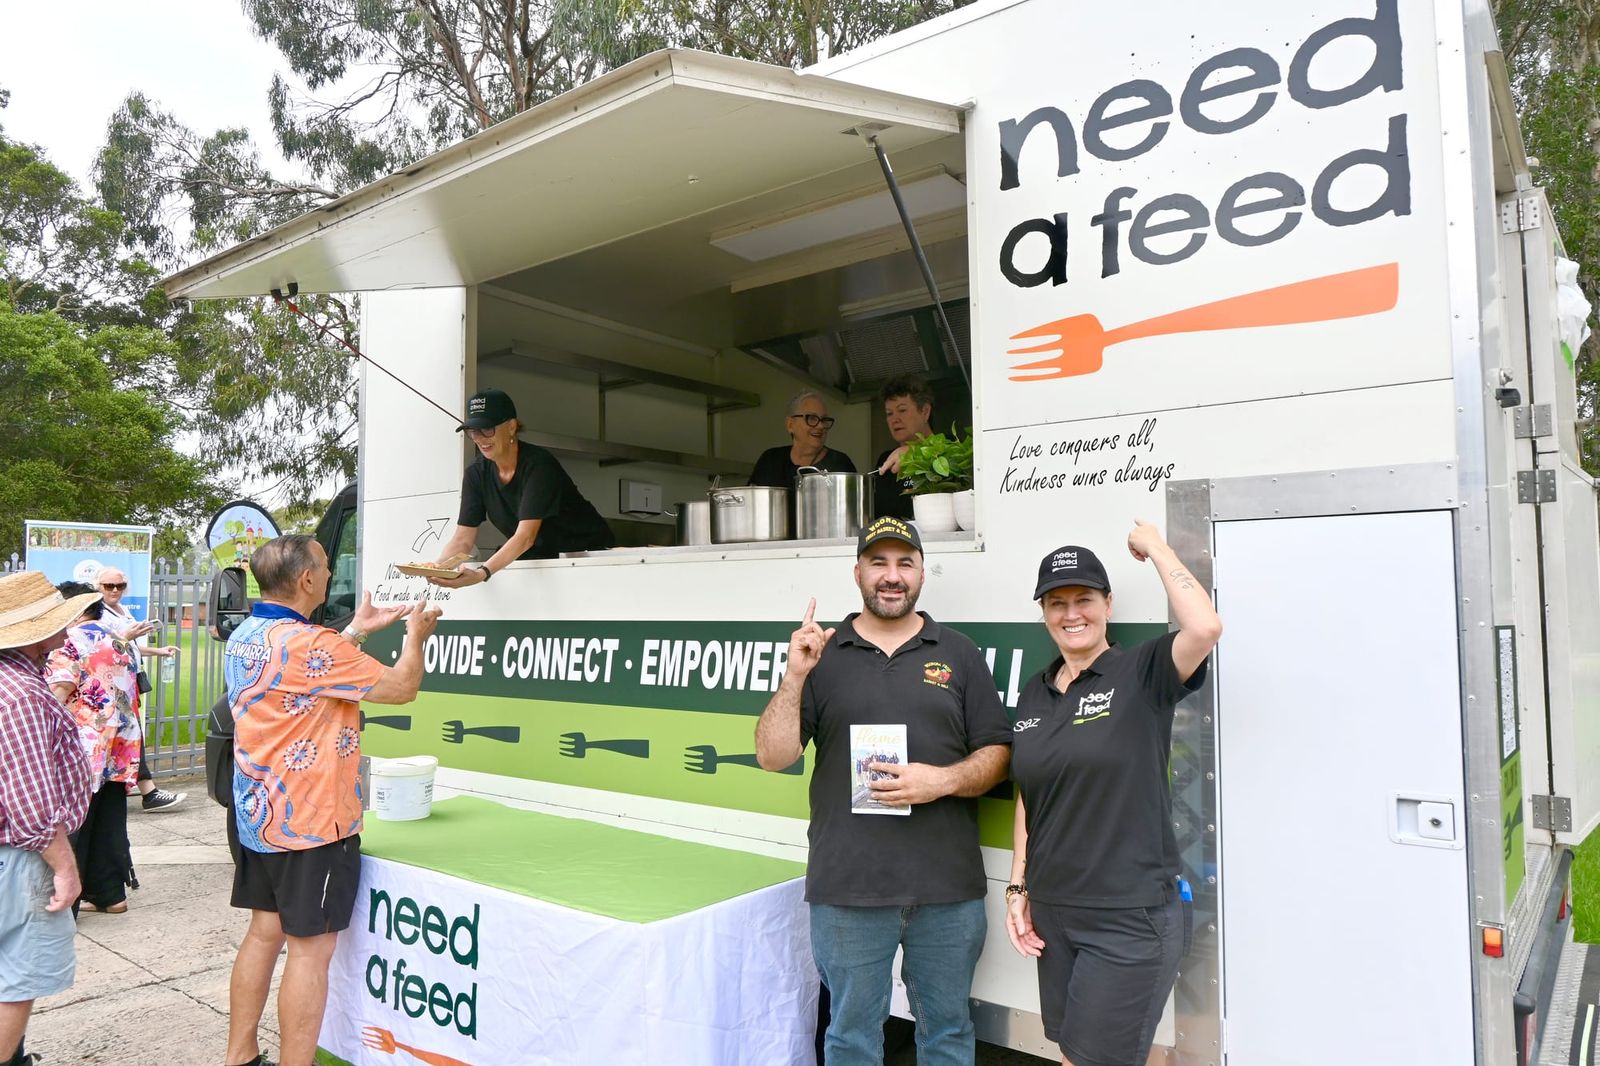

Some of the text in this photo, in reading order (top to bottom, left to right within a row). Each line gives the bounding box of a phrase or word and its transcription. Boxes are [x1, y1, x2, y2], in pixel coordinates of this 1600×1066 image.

[998, 0, 1404, 191] need
[999, 113, 1412, 288] a feed
[1009, 417, 1157, 465] Love conquers all,
[999, 454, 1175, 494] Kindness wins always
[1054, 551, 1077, 560] need
[374, 584, 392, 602] Food
[402, 634, 790, 692] OVIDE CONNECT EMPOWER
[368, 887, 481, 970] need
[365, 954, 478, 1041] a feed
